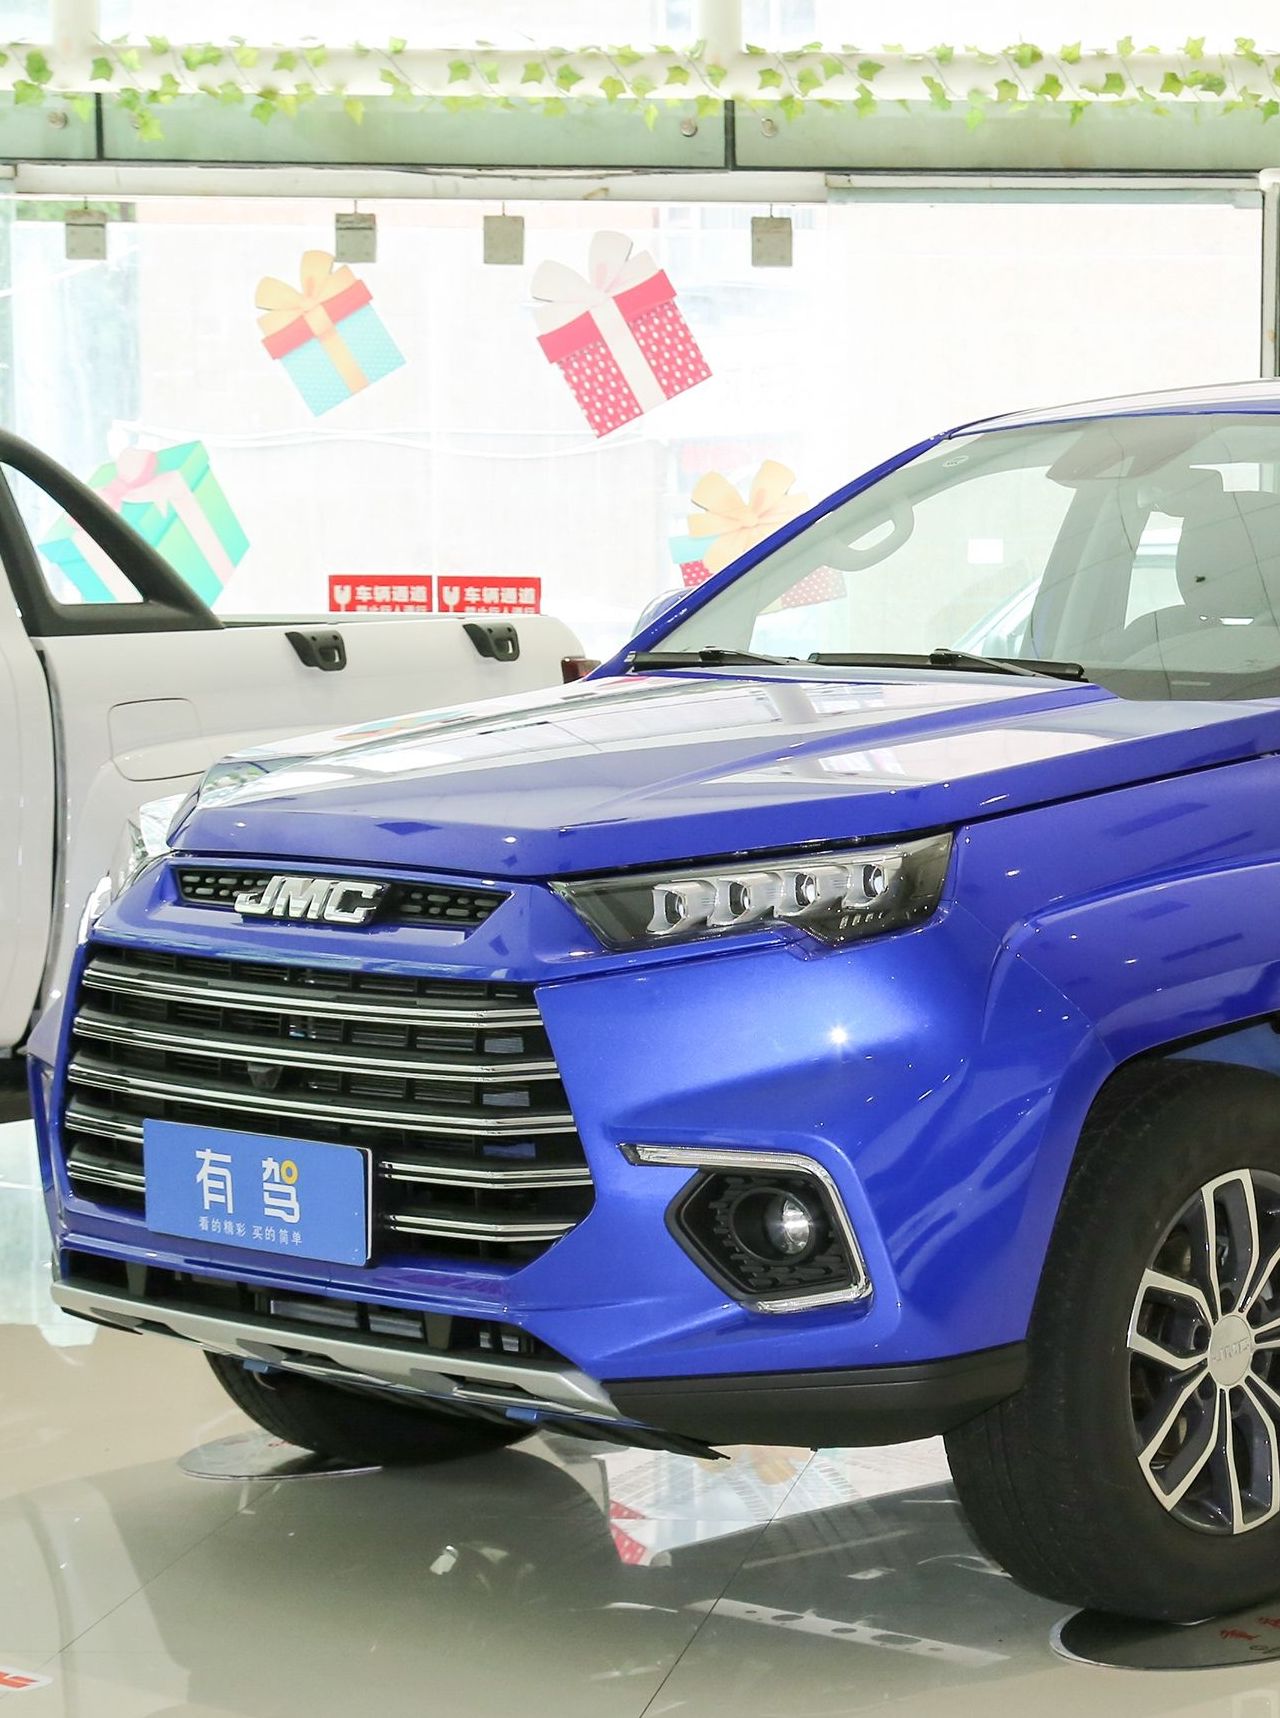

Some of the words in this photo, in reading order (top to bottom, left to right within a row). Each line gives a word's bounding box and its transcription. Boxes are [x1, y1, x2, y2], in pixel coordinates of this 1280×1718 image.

[234, 875, 388, 924] JMC
[195, 1148, 300, 1224] 有驾
[199, 1216, 246, 1237] 看的精彩
[252, 1225, 303, 1246] 买的简单
